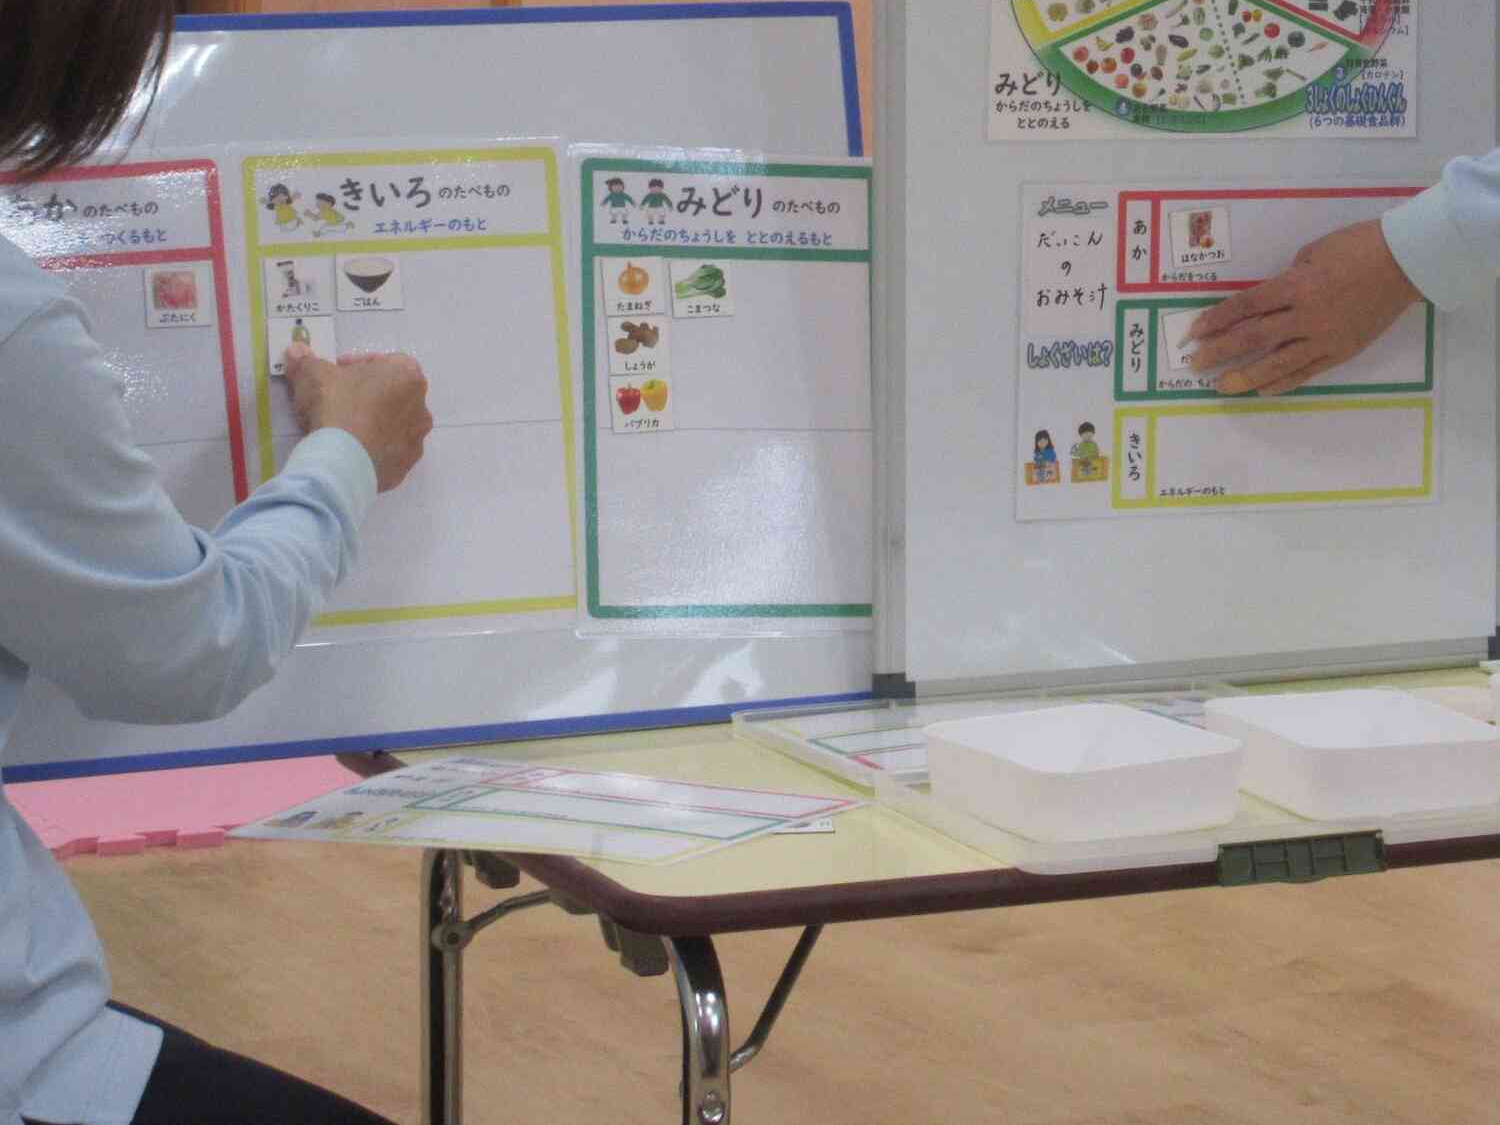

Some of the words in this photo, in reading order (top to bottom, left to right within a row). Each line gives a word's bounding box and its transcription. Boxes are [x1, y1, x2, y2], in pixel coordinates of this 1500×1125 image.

[995, 72, 1061, 96] みどり
[996, 100, 1092, 113] からだのちょうしを
[1017, 116, 1070, 129] ととのえる
[1038, 196, 1109, 217] メニュー
[373, 218, 488, 234] エネルギーのもと
[623, 227, 737, 244] からだのちょうしを
[747, 230, 832, 246] ととのえるもと
[1131, 220, 1148, 261] あか
[1181, 249, 1226, 264] はなかつお
[1060, 260, 1072, 276] の
[1161, 271, 1217, 282] からだをつくる
[353, 297, 382, 307] ごはん
[1036, 283, 1108, 310] おみそ汁
[617, 300, 652, 311] たまねぎ
[688, 303, 721, 314] こまつな
[1129, 322, 1145, 373] みどり
[625, 361, 656, 372] しょうが
[1128, 432, 1142, 482] きいろ
[1160, 486, 1225, 496] エネルギーのもと
